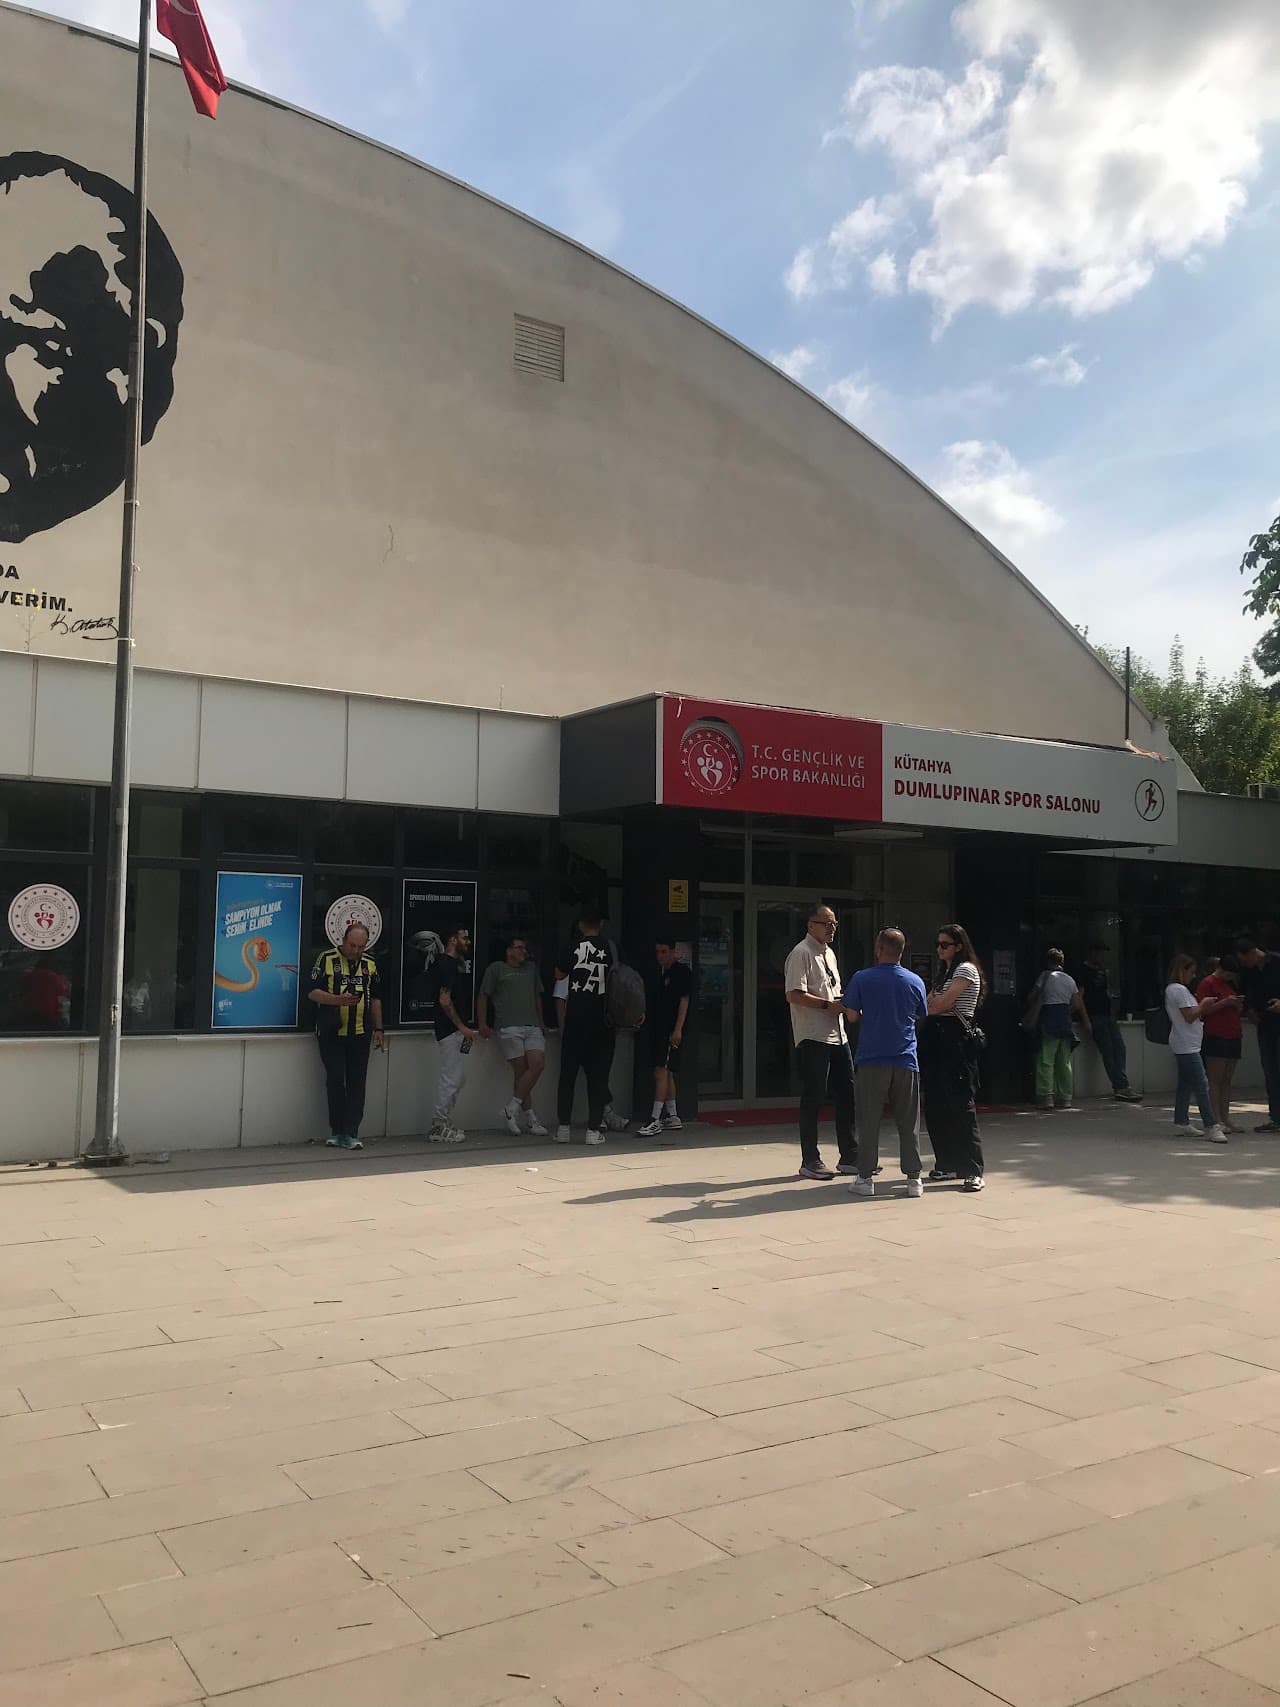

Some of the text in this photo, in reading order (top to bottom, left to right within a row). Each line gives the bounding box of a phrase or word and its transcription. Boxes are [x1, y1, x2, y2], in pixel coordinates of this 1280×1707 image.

[752, 745, 865, 769] T.C. GENÇLİK VE
[894, 753, 952, 774] KÜTAHYA
[752, 765, 865, 788] SPOR BAKANLIĞI
[894, 779, 1100, 814] DUMLUPINAR SPOR SALONU
